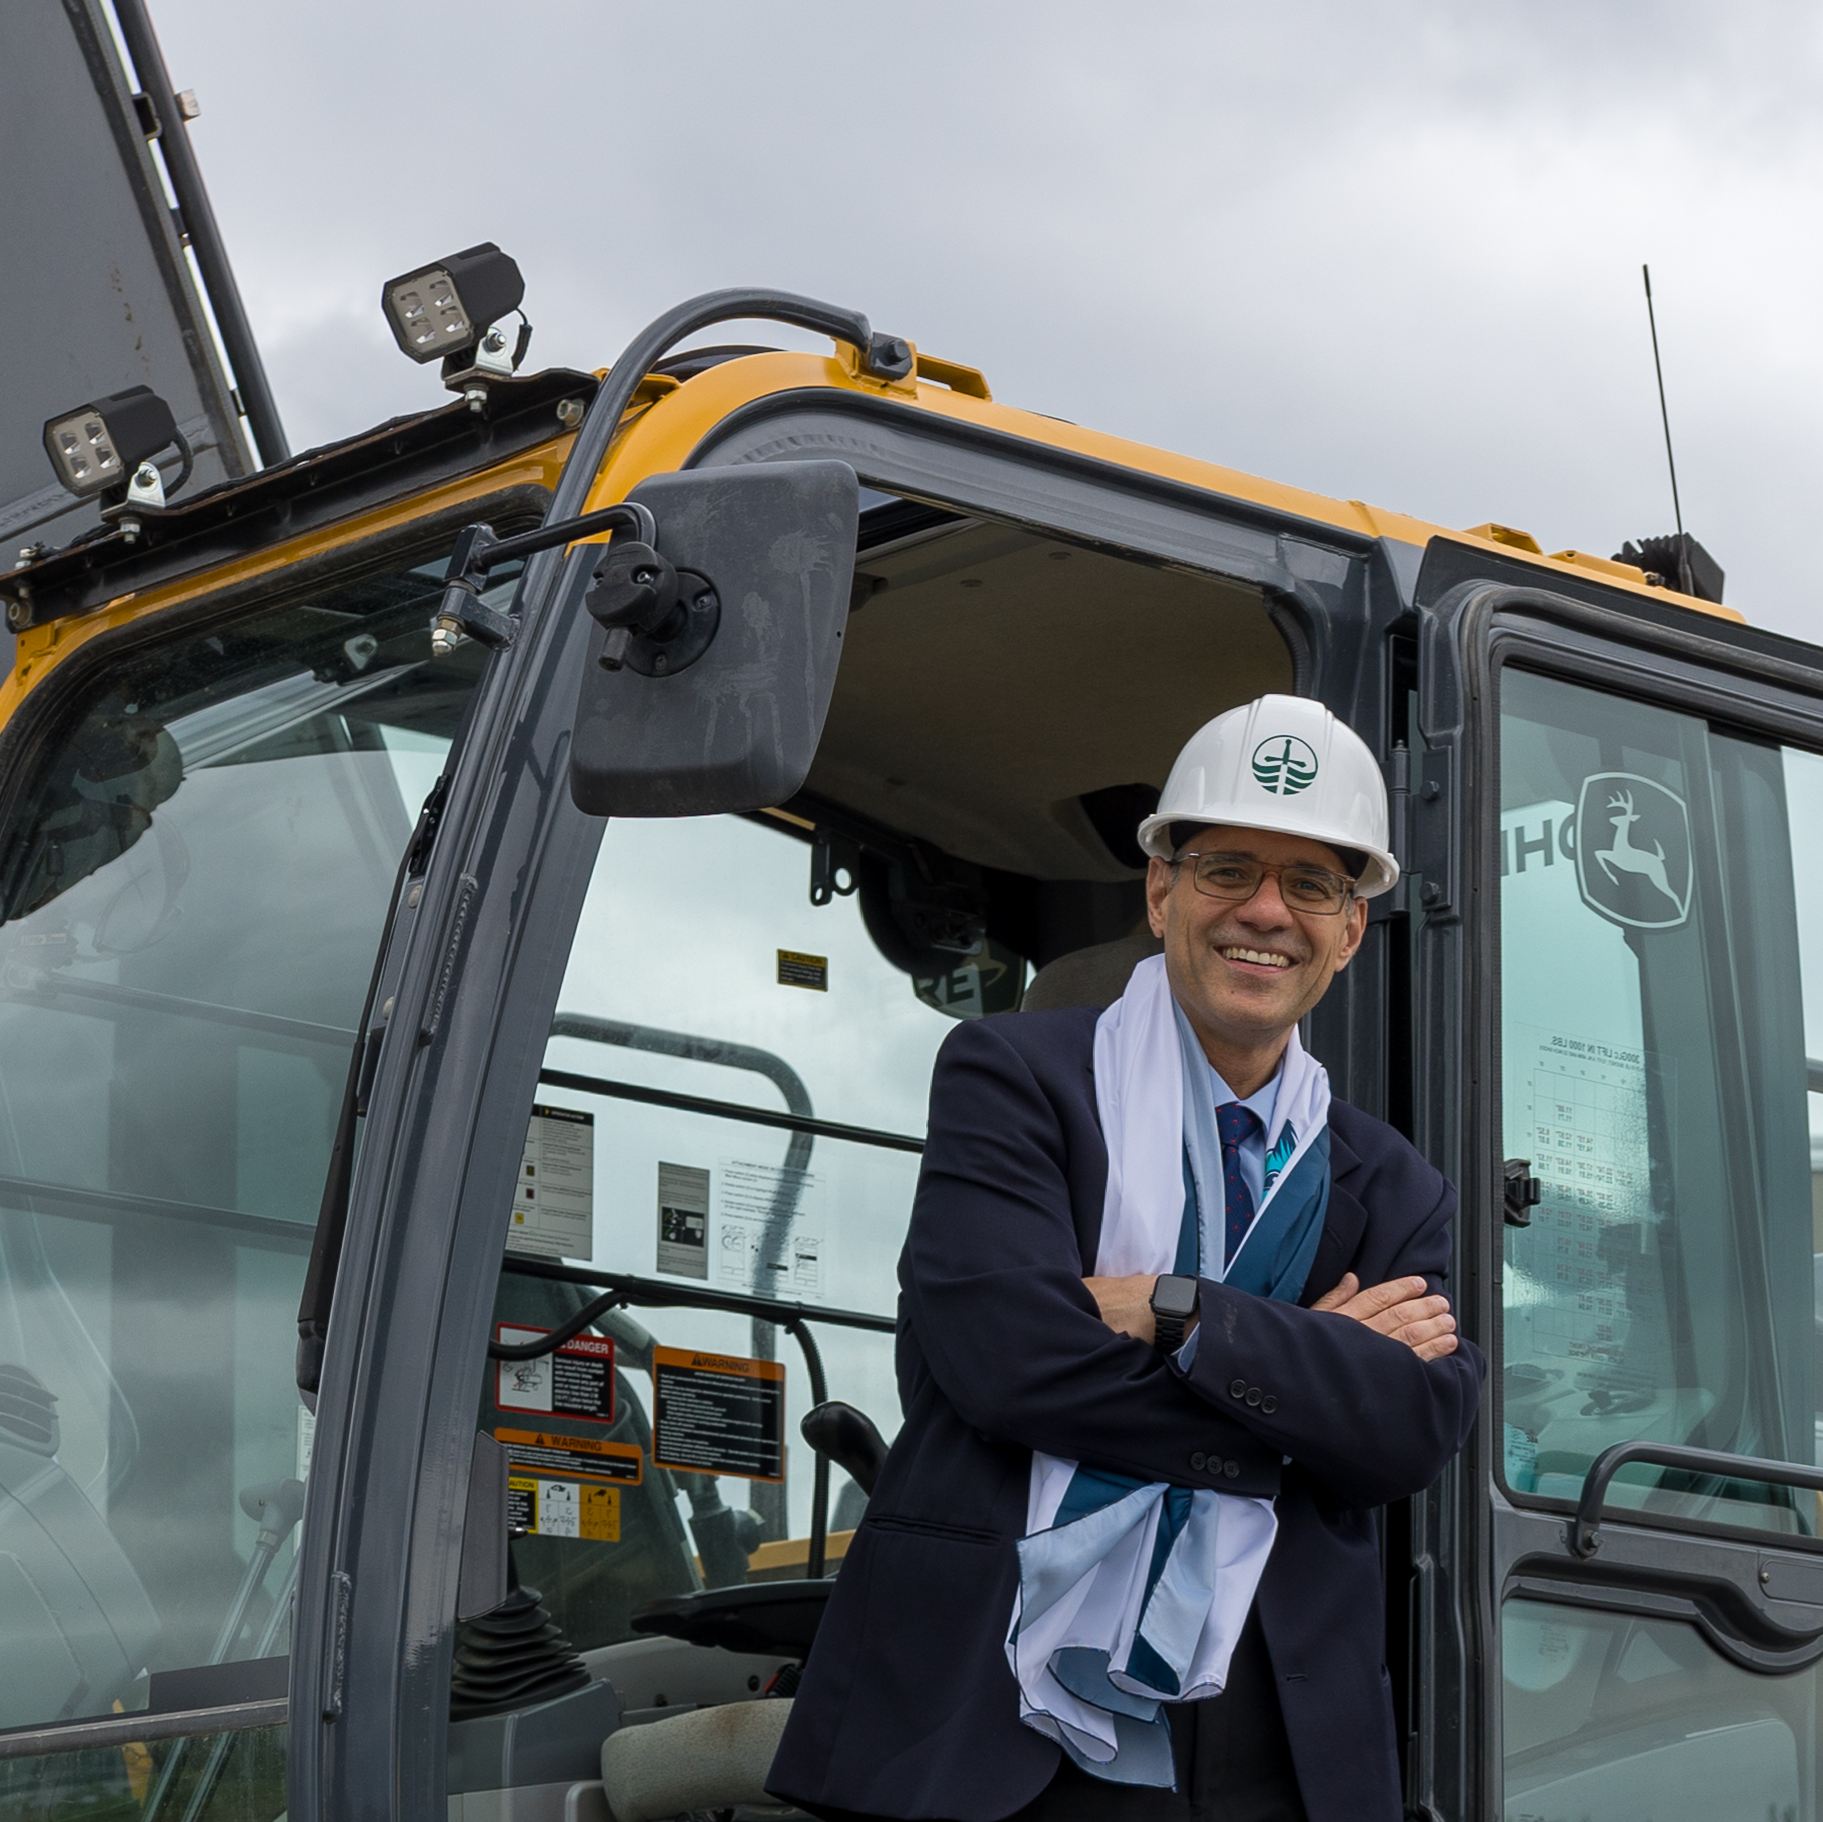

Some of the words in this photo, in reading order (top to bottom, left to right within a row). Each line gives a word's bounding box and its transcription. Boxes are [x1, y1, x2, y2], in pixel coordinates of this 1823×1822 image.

[567, 1340, 609, 1354] DANGER
[702, 1356, 749, 1372] WARNING
[552, 1436, 602, 1452] WARNING
[509, 1480, 534, 1488] AUTION
